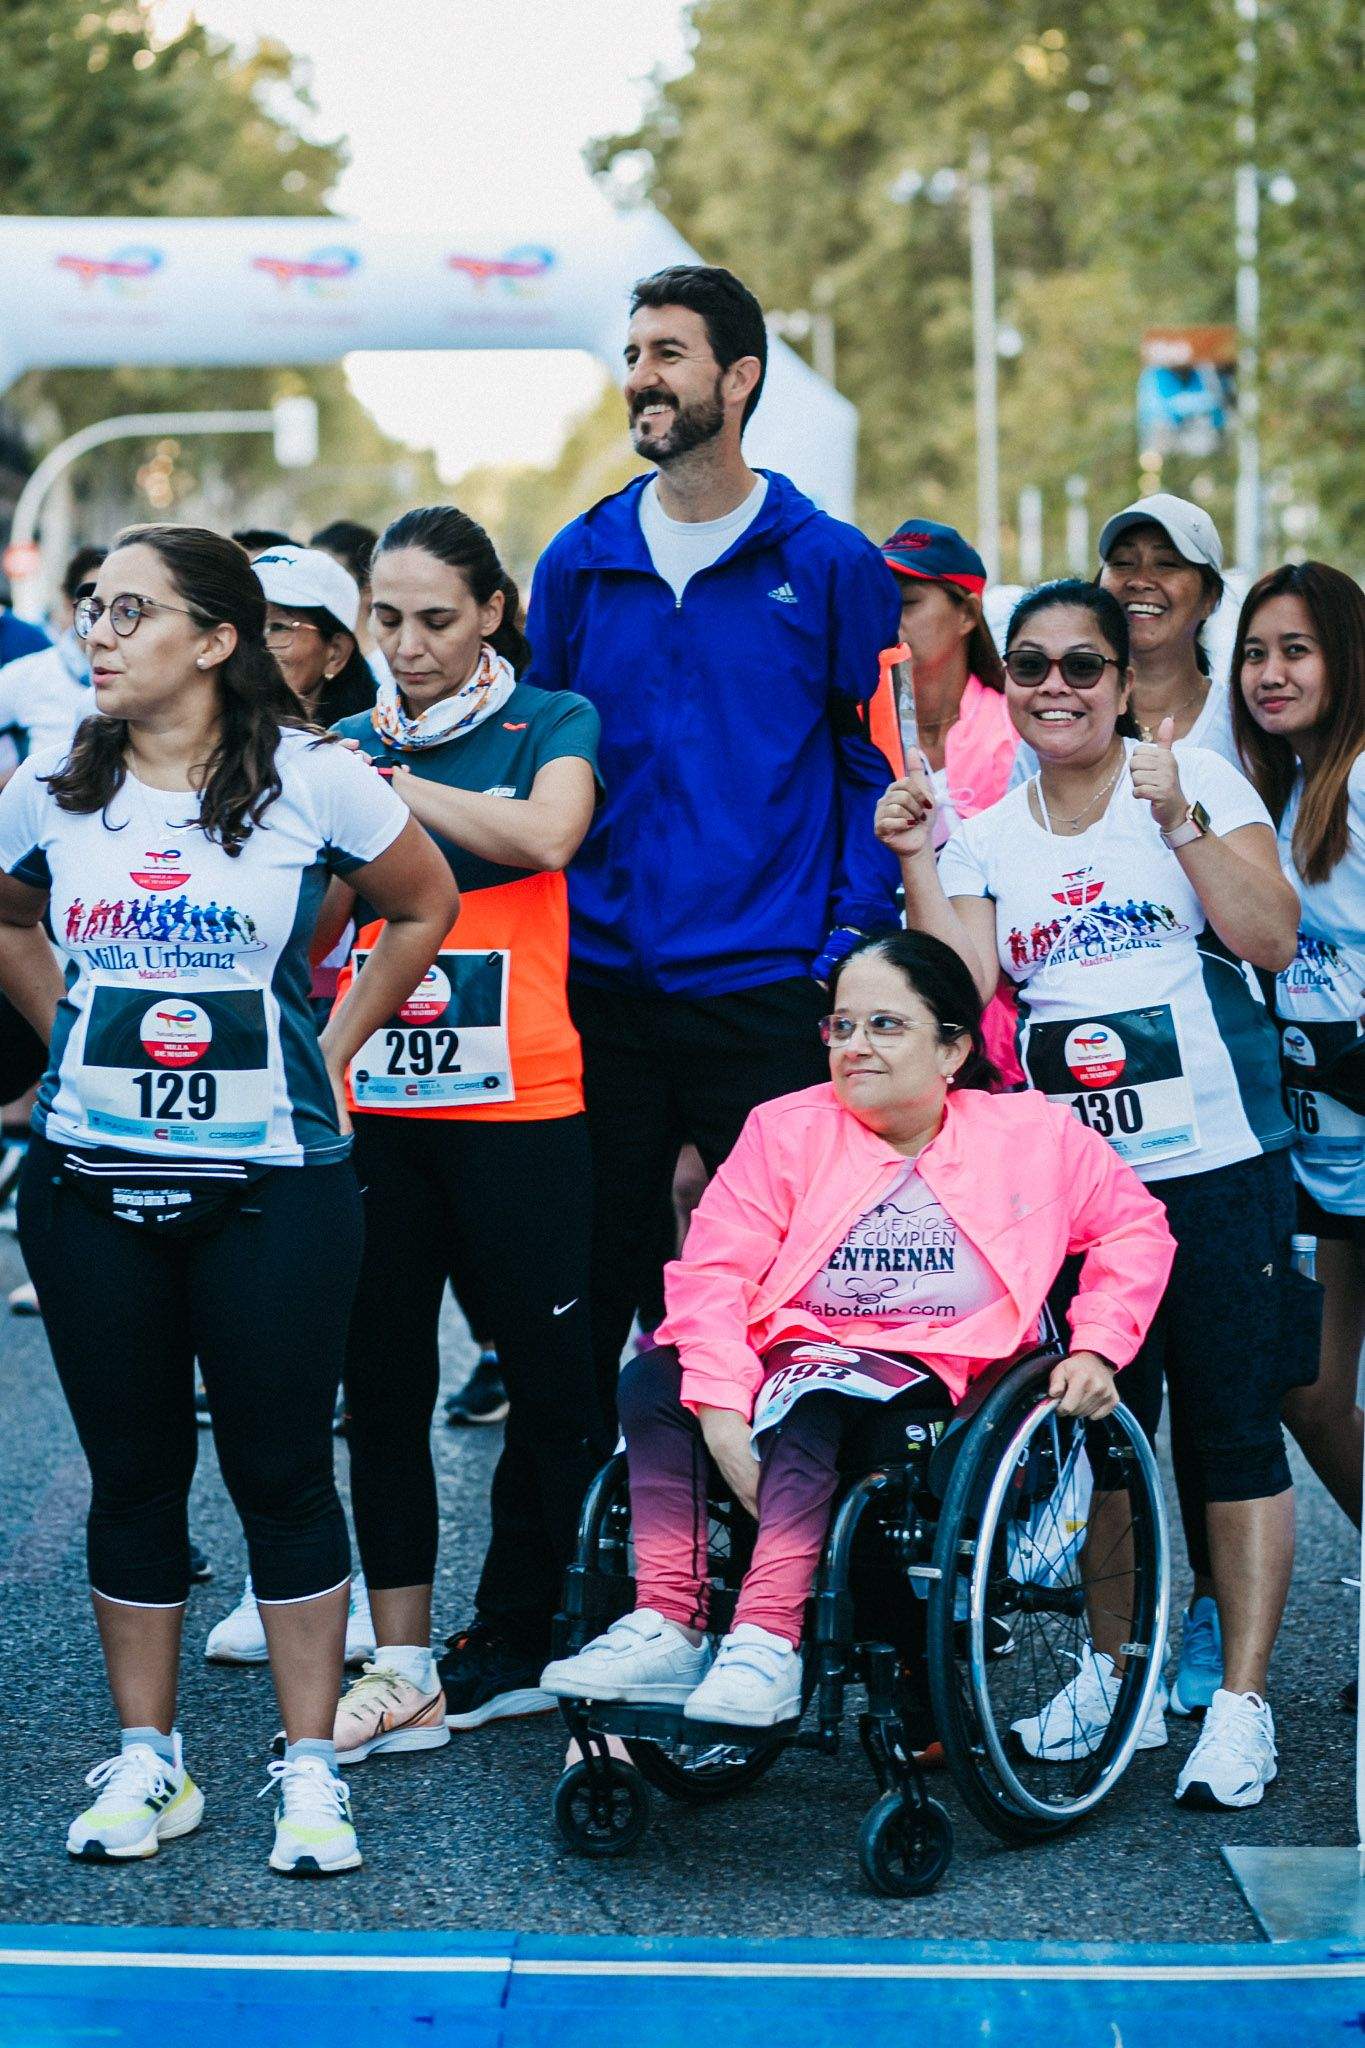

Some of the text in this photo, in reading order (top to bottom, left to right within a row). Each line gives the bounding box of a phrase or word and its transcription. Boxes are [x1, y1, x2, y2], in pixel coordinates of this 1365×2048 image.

[143, 945, 235, 969] Urbana
[138, 969, 177, 979] Madrid
[386, 1029, 461, 1076] 292
[132, 1071, 217, 1121] 129
[1071, 1088, 1144, 1138] 130
[863, 1231, 956, 1247] CUMPLEN
[828, 1247, 955, 1272] ENTRENAN
[768, 1363, 852, 1402] 293
